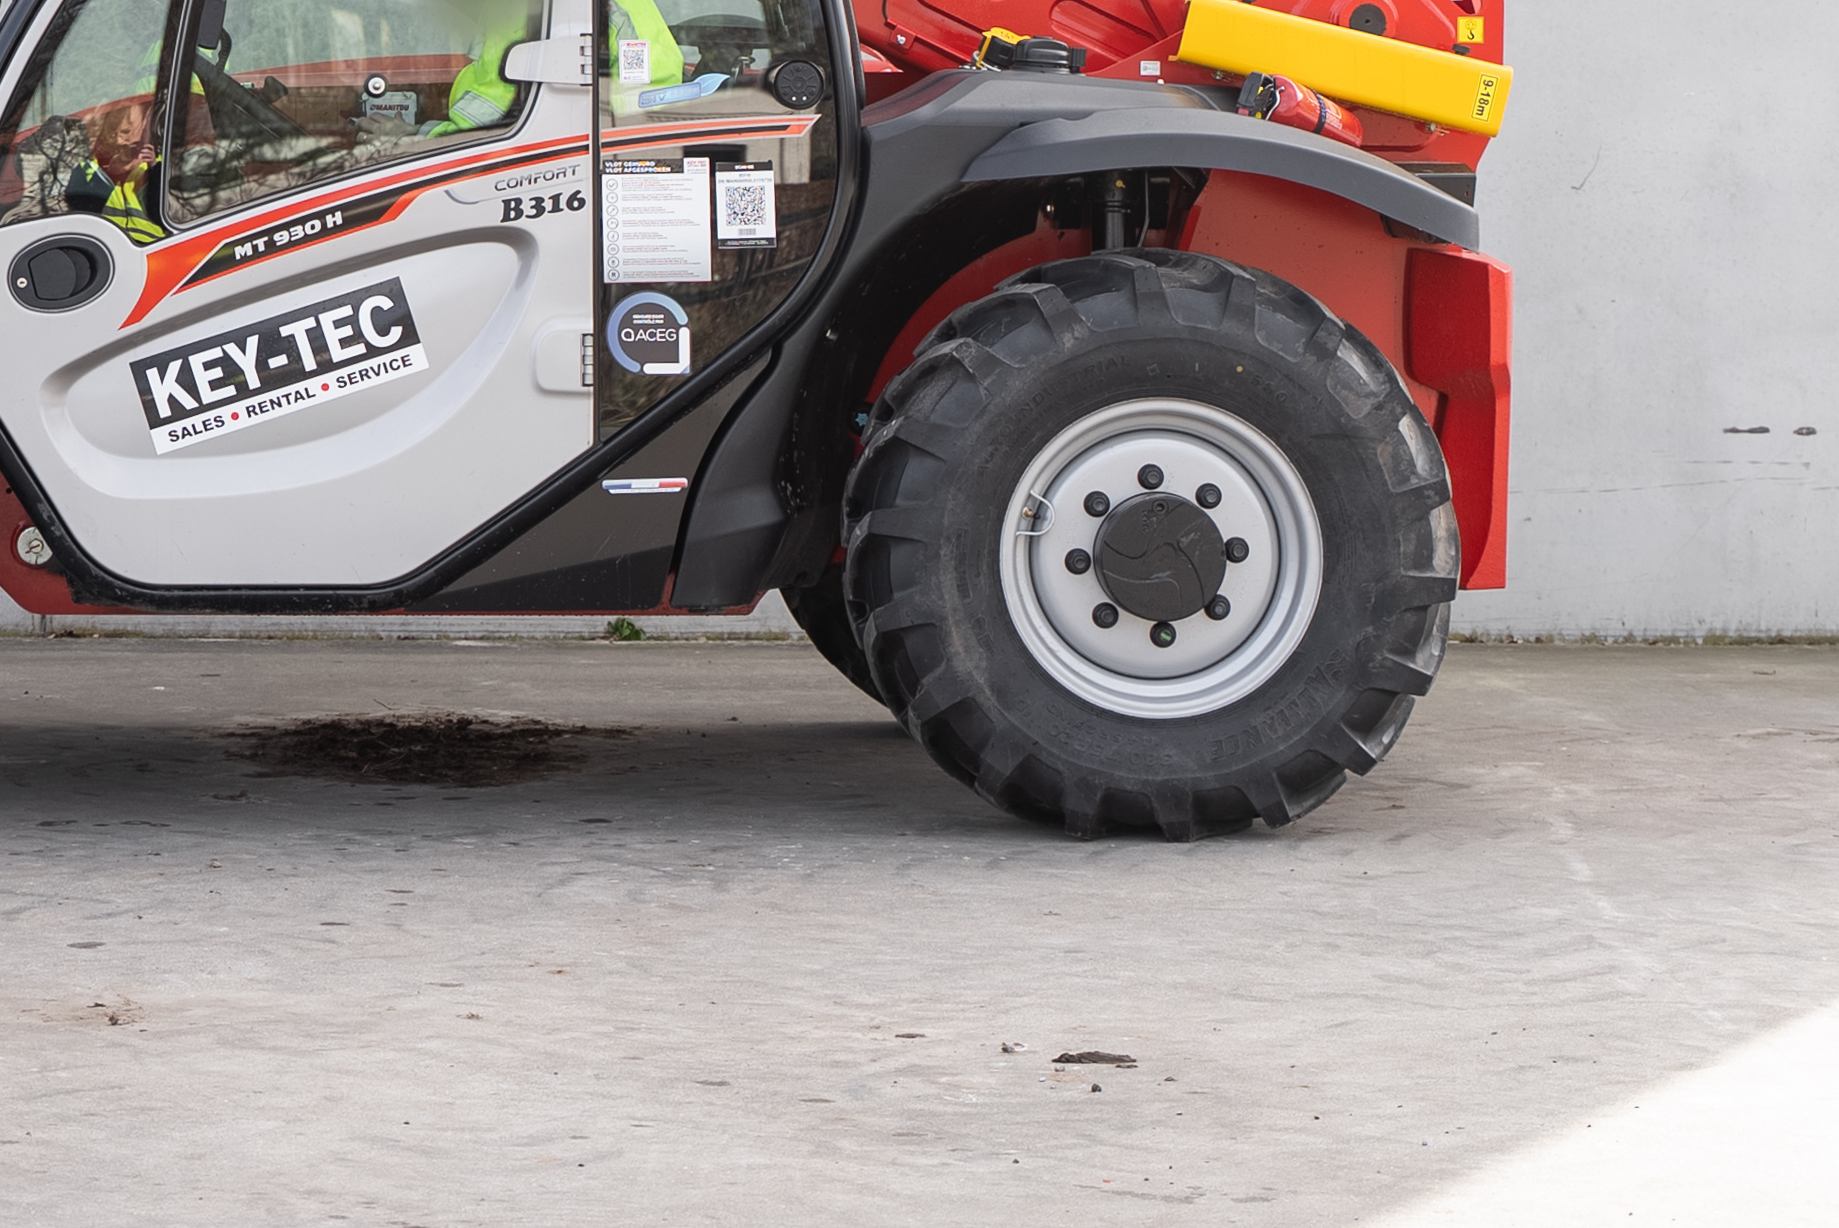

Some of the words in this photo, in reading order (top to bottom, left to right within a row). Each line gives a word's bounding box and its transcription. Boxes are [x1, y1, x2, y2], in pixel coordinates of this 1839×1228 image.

[1475, 79, 1494, 116] 9-18m
[494, 164, 581, 191] COMFORT
[500, 189, 586, 223] B316
[233, 237, 269, 260] MT
[273, 218, 322, 247] 930
[325, 211, 343, 228] H
[145, 295, 403, 419] KEY-TEC
[168, 415, 225, 443] SALES
[245, 387, 316, 418] RENTAL
[336, 355, 413, 389] SERVICE
